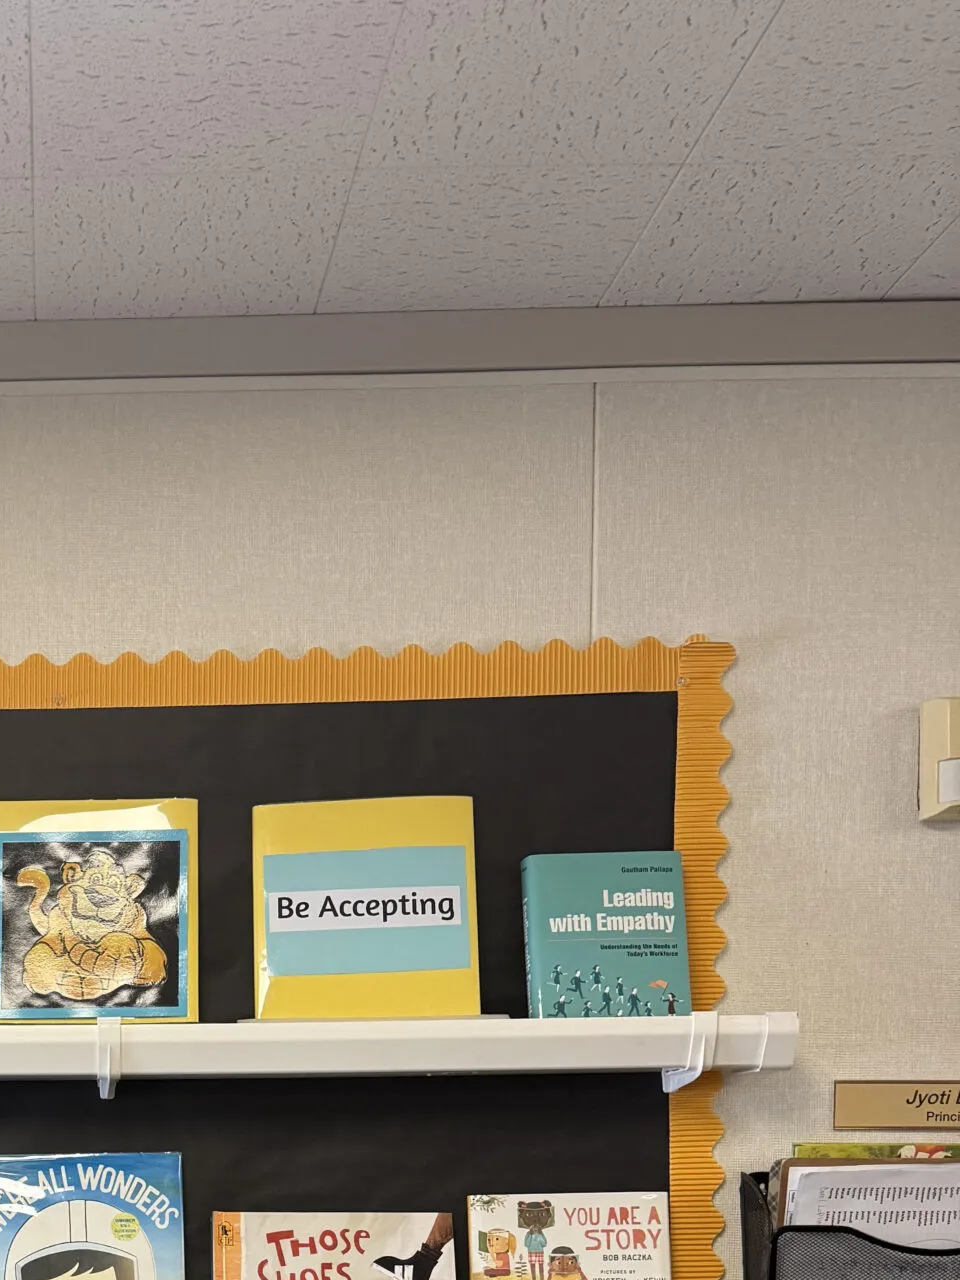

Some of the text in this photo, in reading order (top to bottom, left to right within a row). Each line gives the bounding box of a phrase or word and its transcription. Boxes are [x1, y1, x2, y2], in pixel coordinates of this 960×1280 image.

[276, 892, 455, 922] Be Accepting
[603, 889, 674, 909] Leading
[549, 912, 675, 933] with Empathy
[906, 1090, 951, 1108] Jyoti
[38, 1165, 74, 1194] ALL
[77, 1163, 179, 1230] WONDERS
[564, 1206, 661, 1226] YOU ARE A
[584, 1228, 662, 1251] STORY
